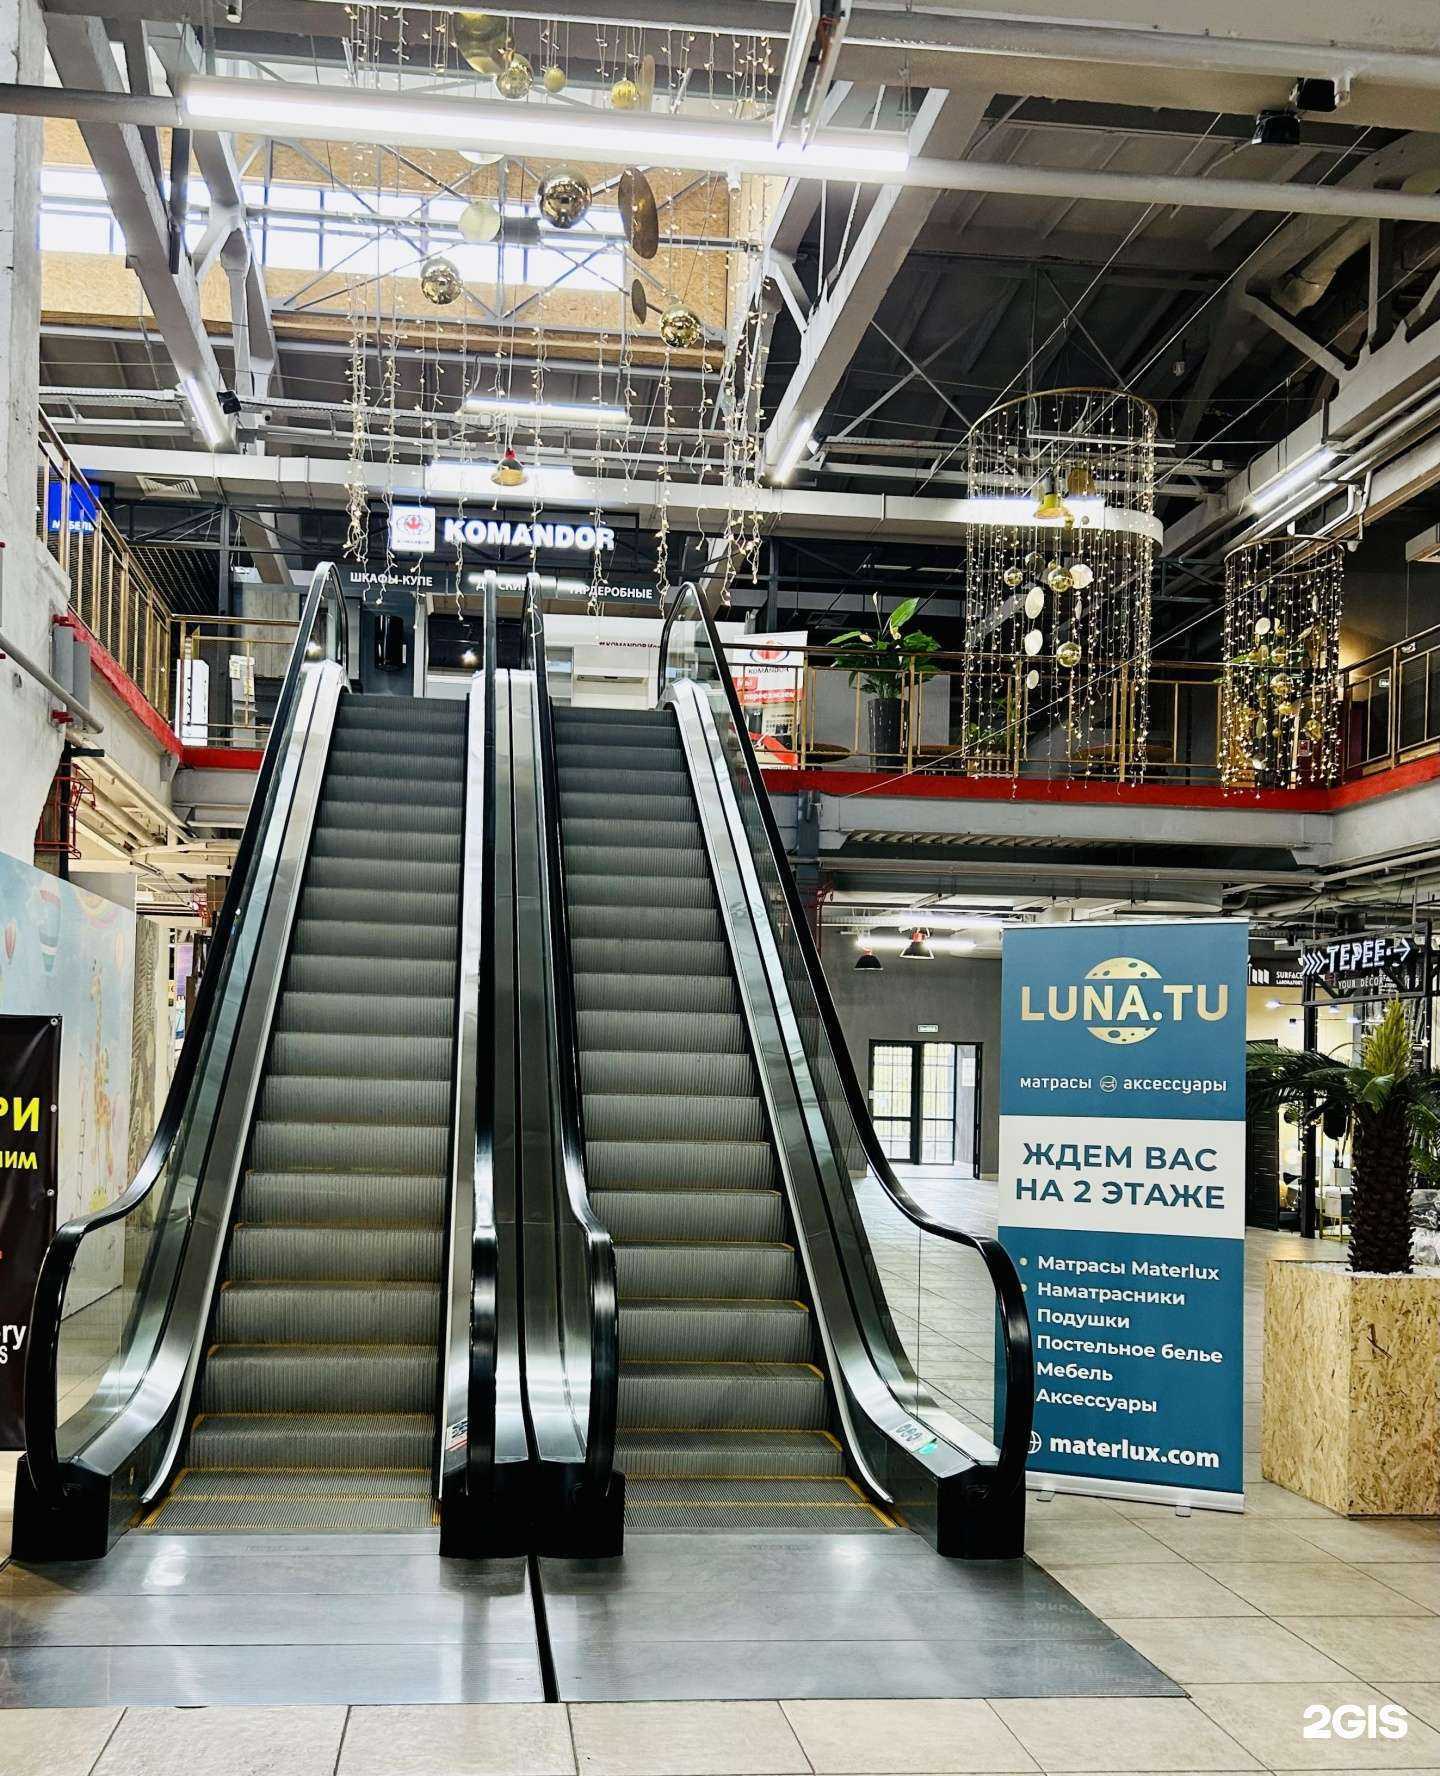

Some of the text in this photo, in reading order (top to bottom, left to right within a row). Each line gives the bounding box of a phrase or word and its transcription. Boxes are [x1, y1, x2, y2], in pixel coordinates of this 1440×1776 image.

[52, 520, 95, 531] МБЕЛЬ
[444, 518, 615, 550] KOMANDOR
[350, 572, 433, 587] ШКАФЫ-КУПЕ
[1327, 939, 1386, 973] TEPEE
[1021, 984, 1229, 1022] LUNA.TU
[1020, 1075, 1227, 1094] матрасы аксессуары
[0, 1151, 38, 1169] ИМ
[1023, 1143, 1218, 1172] ЖДЕМ ВАС
[1016, 1178, 1225, 1209] НА 2 ЭТАЖЕ
[1037, 1255, 1221, 1281] Матрасы Materlux
[1037, 1282, 1186, 1306] Наматрасники
[1037, 1308, 1130, 1329] Подушки
[0, 1325, 27, 1350] ry
[1037, 1335, 1223, 1364] Постельное белье
[1037, 1361, 1114, 1382] Мебель
[1036, 1388, 1157, 1413] Аксессуары
[1049, 1435, 1220, 1468] materlux.com
